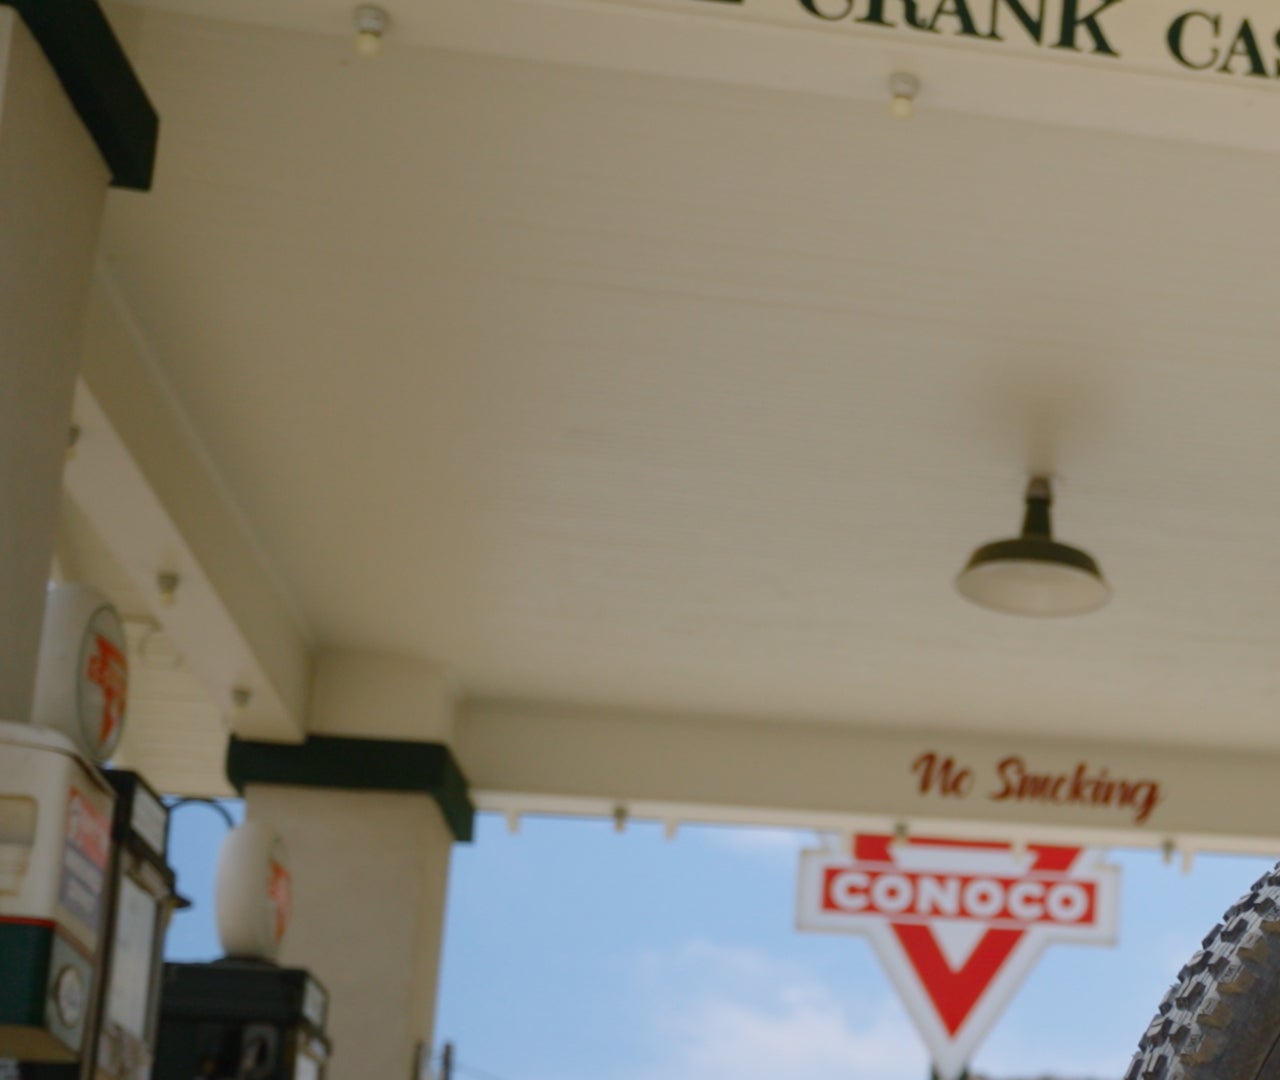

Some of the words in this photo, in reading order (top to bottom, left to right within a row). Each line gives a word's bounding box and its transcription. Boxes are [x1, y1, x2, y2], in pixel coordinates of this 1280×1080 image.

[912, 751, 975, 797] No
[990, 756, 1162, 823] Smoking
[830, 872, 1089, 922] CONOCO
